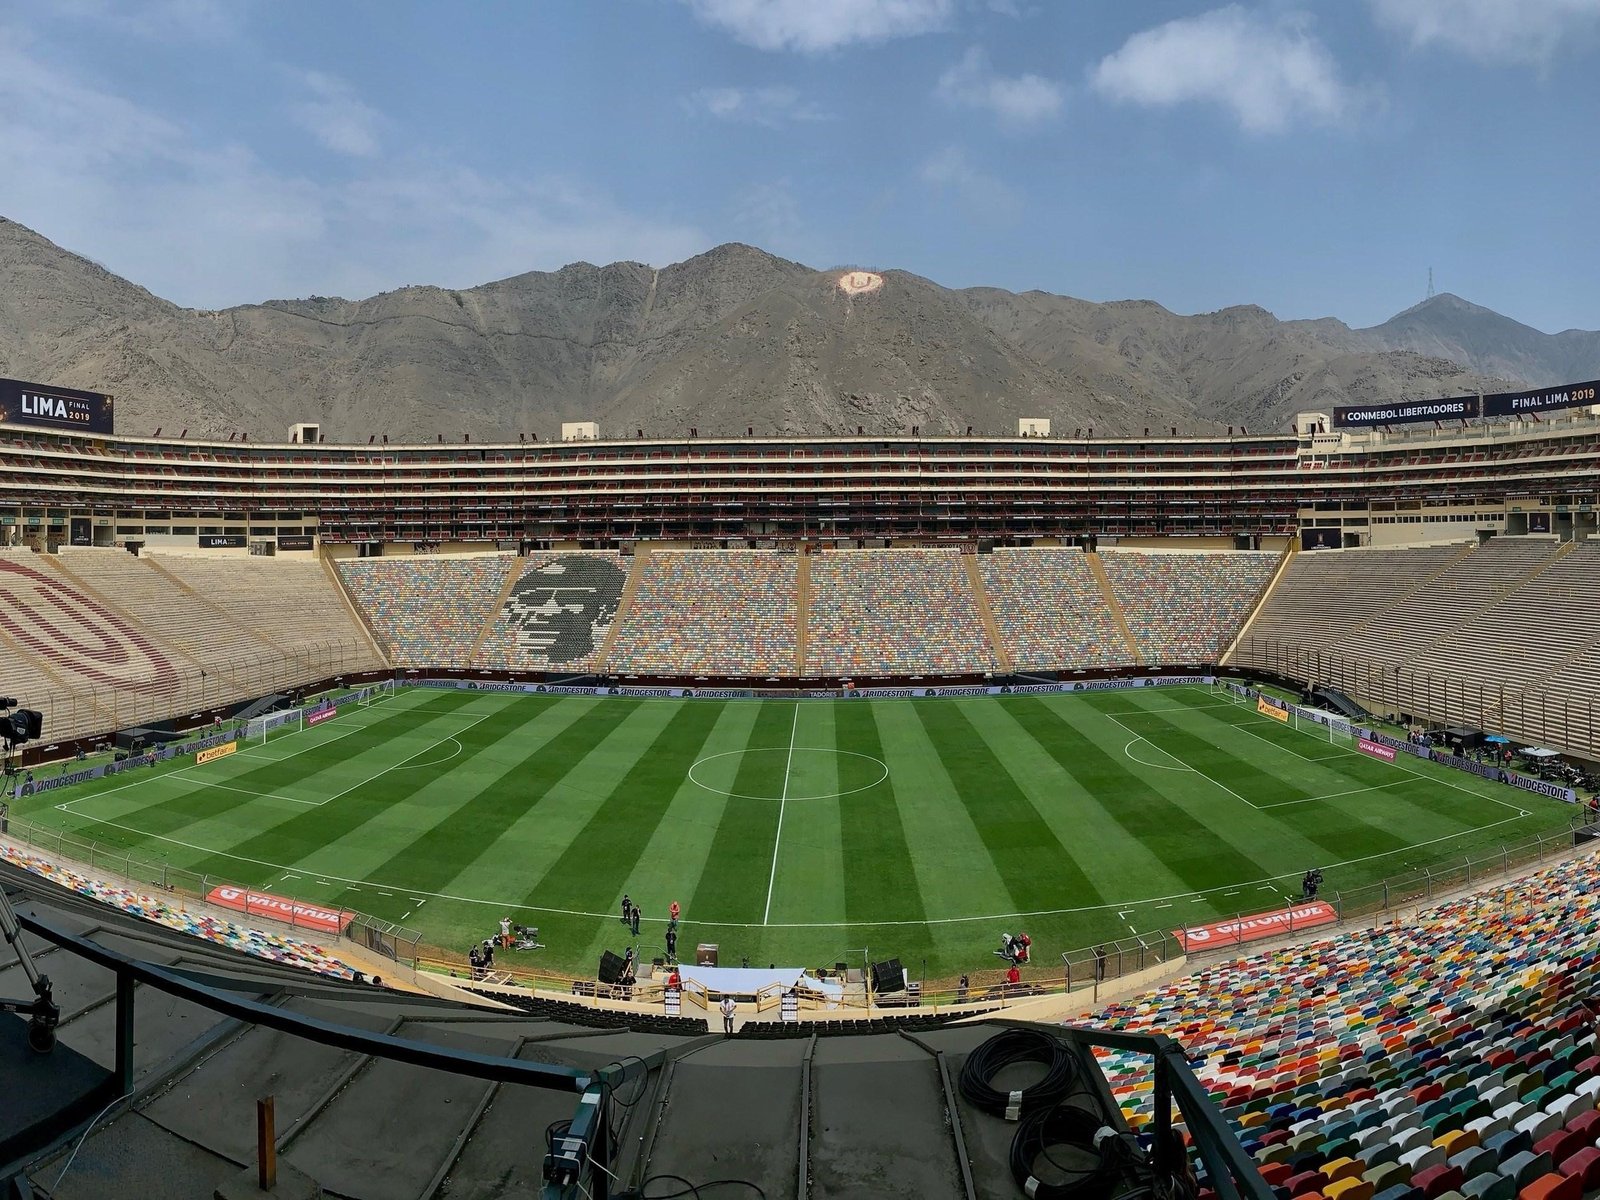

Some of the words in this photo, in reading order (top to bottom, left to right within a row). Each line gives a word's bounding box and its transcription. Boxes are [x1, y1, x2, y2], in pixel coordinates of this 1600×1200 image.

[1512, 396, 1542, 409] FINAL
[1545, 392, 1569, 404] LIMA
[1571, 388, 1595, 401] 2019
[21, 394, 68, 418] LIMA
[69, 401, 90, 410] FINAL
[69, 411, 90, 420] 2019
[1347, 409, 1398, 421] CONMEBOL
[1399, 403, 1464, 417] LIBERTADORES
[1086, 680, 1134, 690] BRIDGESTONE
[1156, 676, 1204, 686] BRIDGESTONE
[480, 683, 526, 692] BRIDGESTONE
[548, 686, 598, 694] BRIDGESTONE
[620, 688, 672, 696] BRIDGESTONE
[938, 688, 990, 696] BRIDGESTONE
[1012, 684, 1064, 694] BRIDGESTONE
[694, 690, 746, 698] BRIDGESTONE
[862, 690, 914, 698] BRIDGESTONE
[186, 734, 226, 753] BRIDGESTONE
[1380, 734, 1420, 754] BRIDGESTONE
[1358, 742, 1374, 752] QATAR
[1374, 747, 1394, 759] AIRWAYS
[36, 769, 94, 793] BRIDGESTONE
[1510, 771, 1569, 800] BRIDGESTONE
